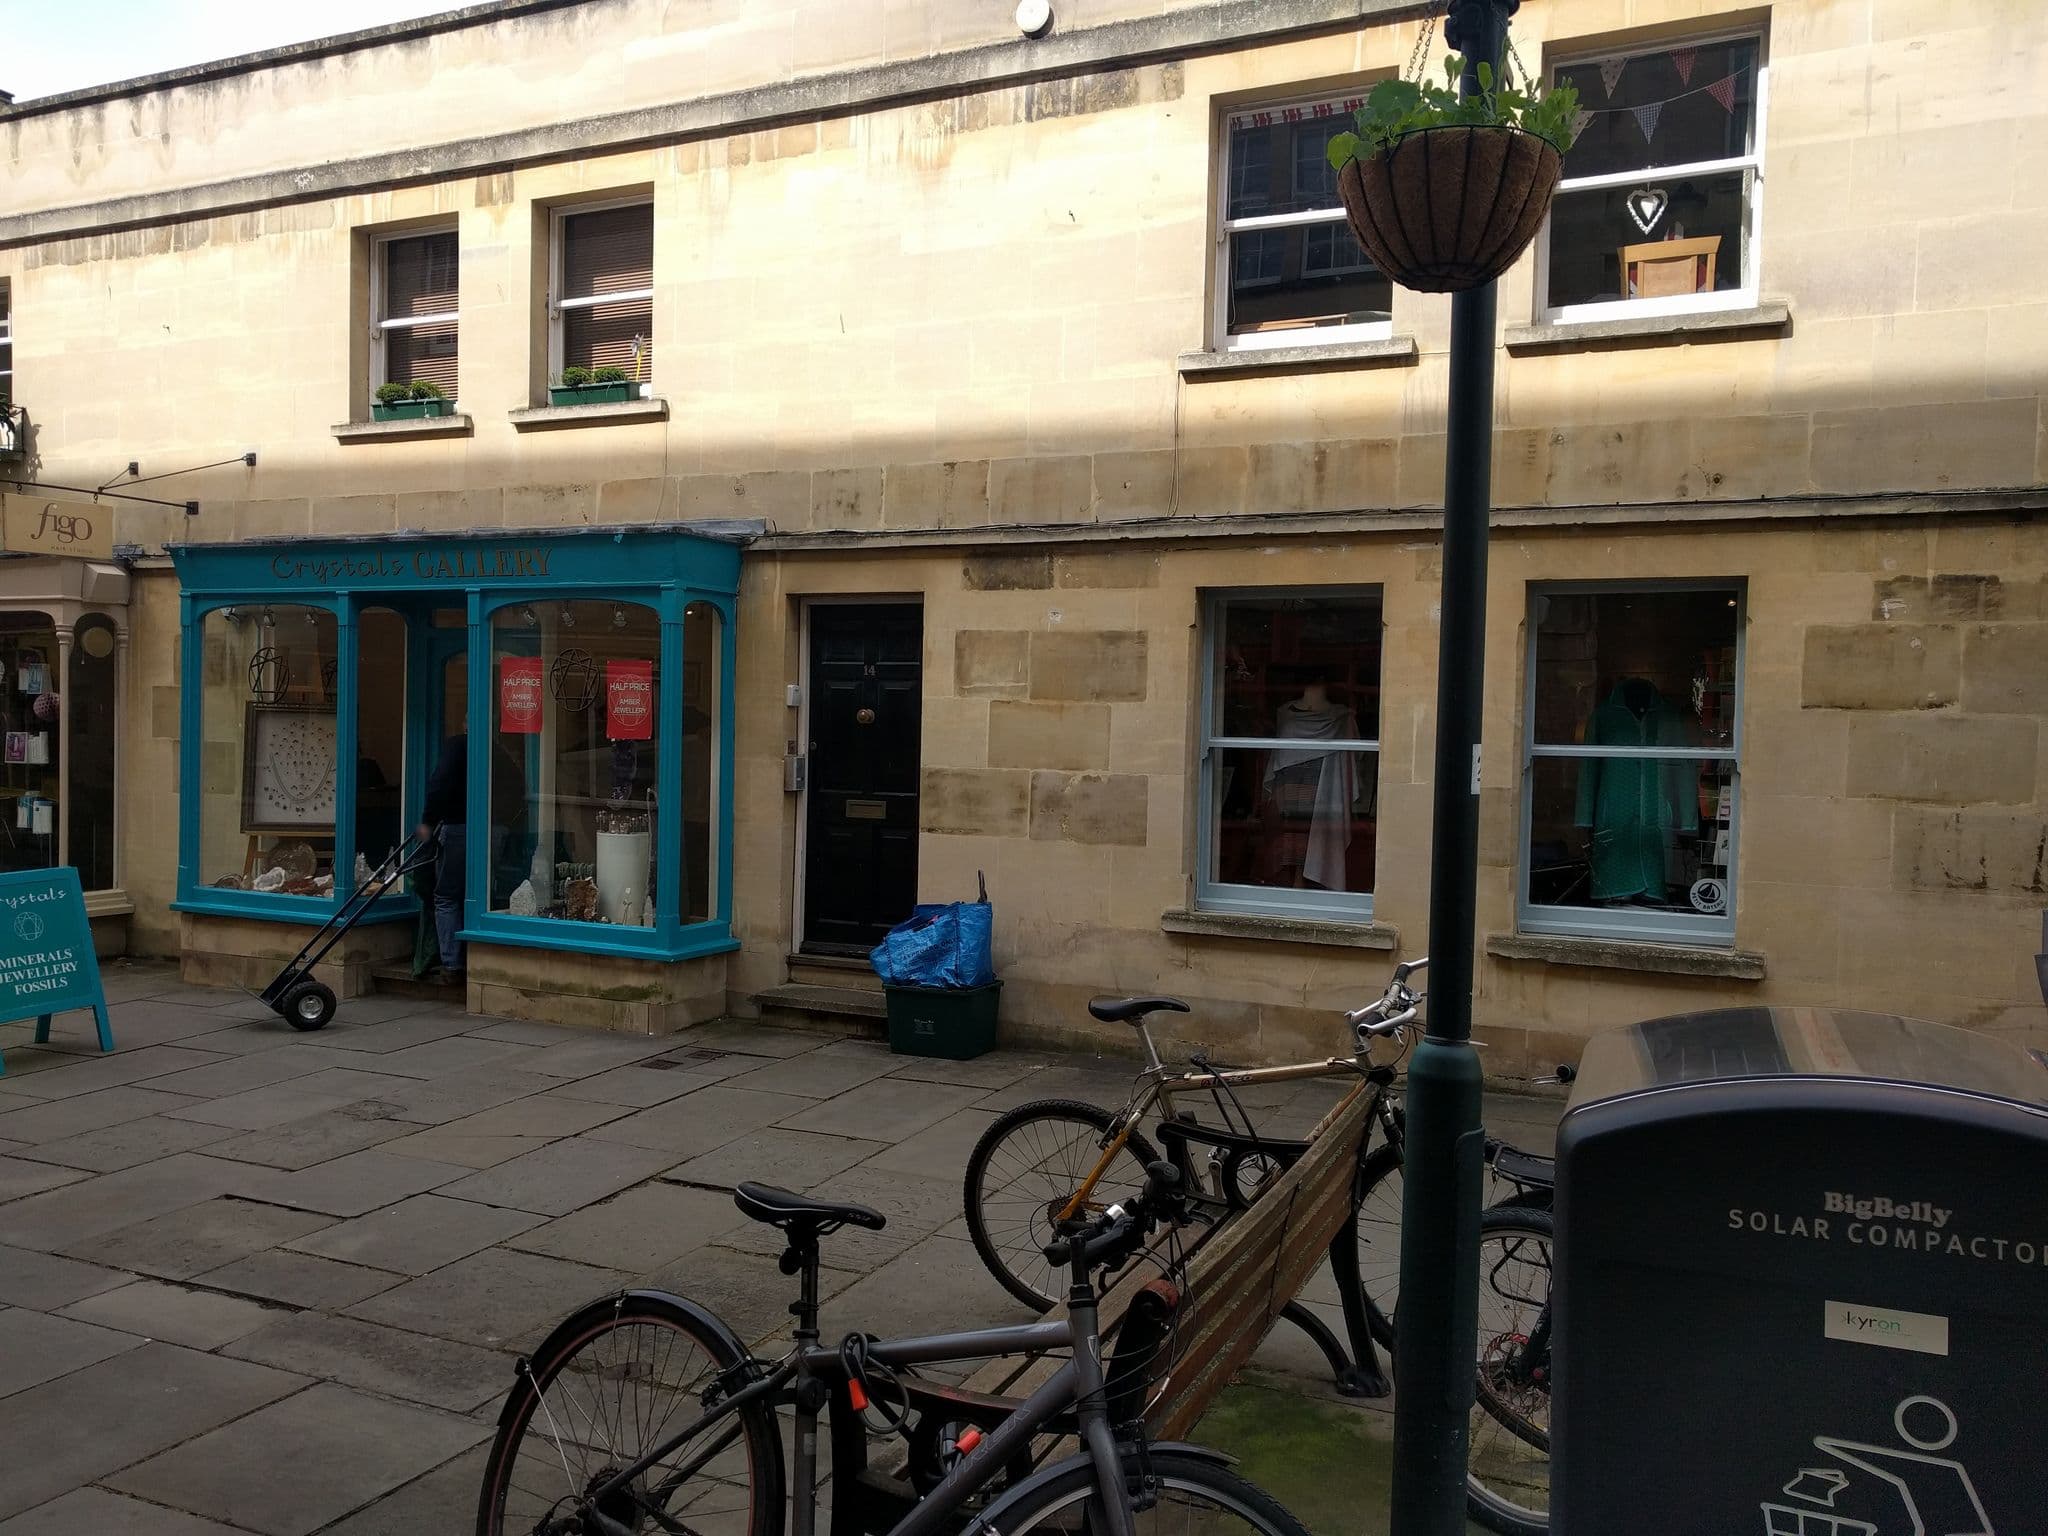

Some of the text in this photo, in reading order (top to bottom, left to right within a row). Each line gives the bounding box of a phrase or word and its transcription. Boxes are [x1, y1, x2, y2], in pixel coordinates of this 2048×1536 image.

[30, 503, 93, 544] figo
[271, 549, 552, 584] Crystals GALLERY
[863, 665, 876, 676] 14
[503, 678, 541, 687] HALF PRICE
[609, 682, 650, 691] HALF PRICE
[506, 701, 537, 709] JEWELLERY
[612, 706, 647, 715] JEWELLERY
[618, 698, 640, 706] AMBER
[0, 948, 72, 969] MINERALS
[0, 961, 78, 984] JEWELLERY
[15, 976, 68, 995] FOSSILS
[1823, 1191, 1952, 1228] BigBelly
[1727, 1208, 1831, 1241] SOLAR
[1844, 1310, 1901, 1332] kyron
